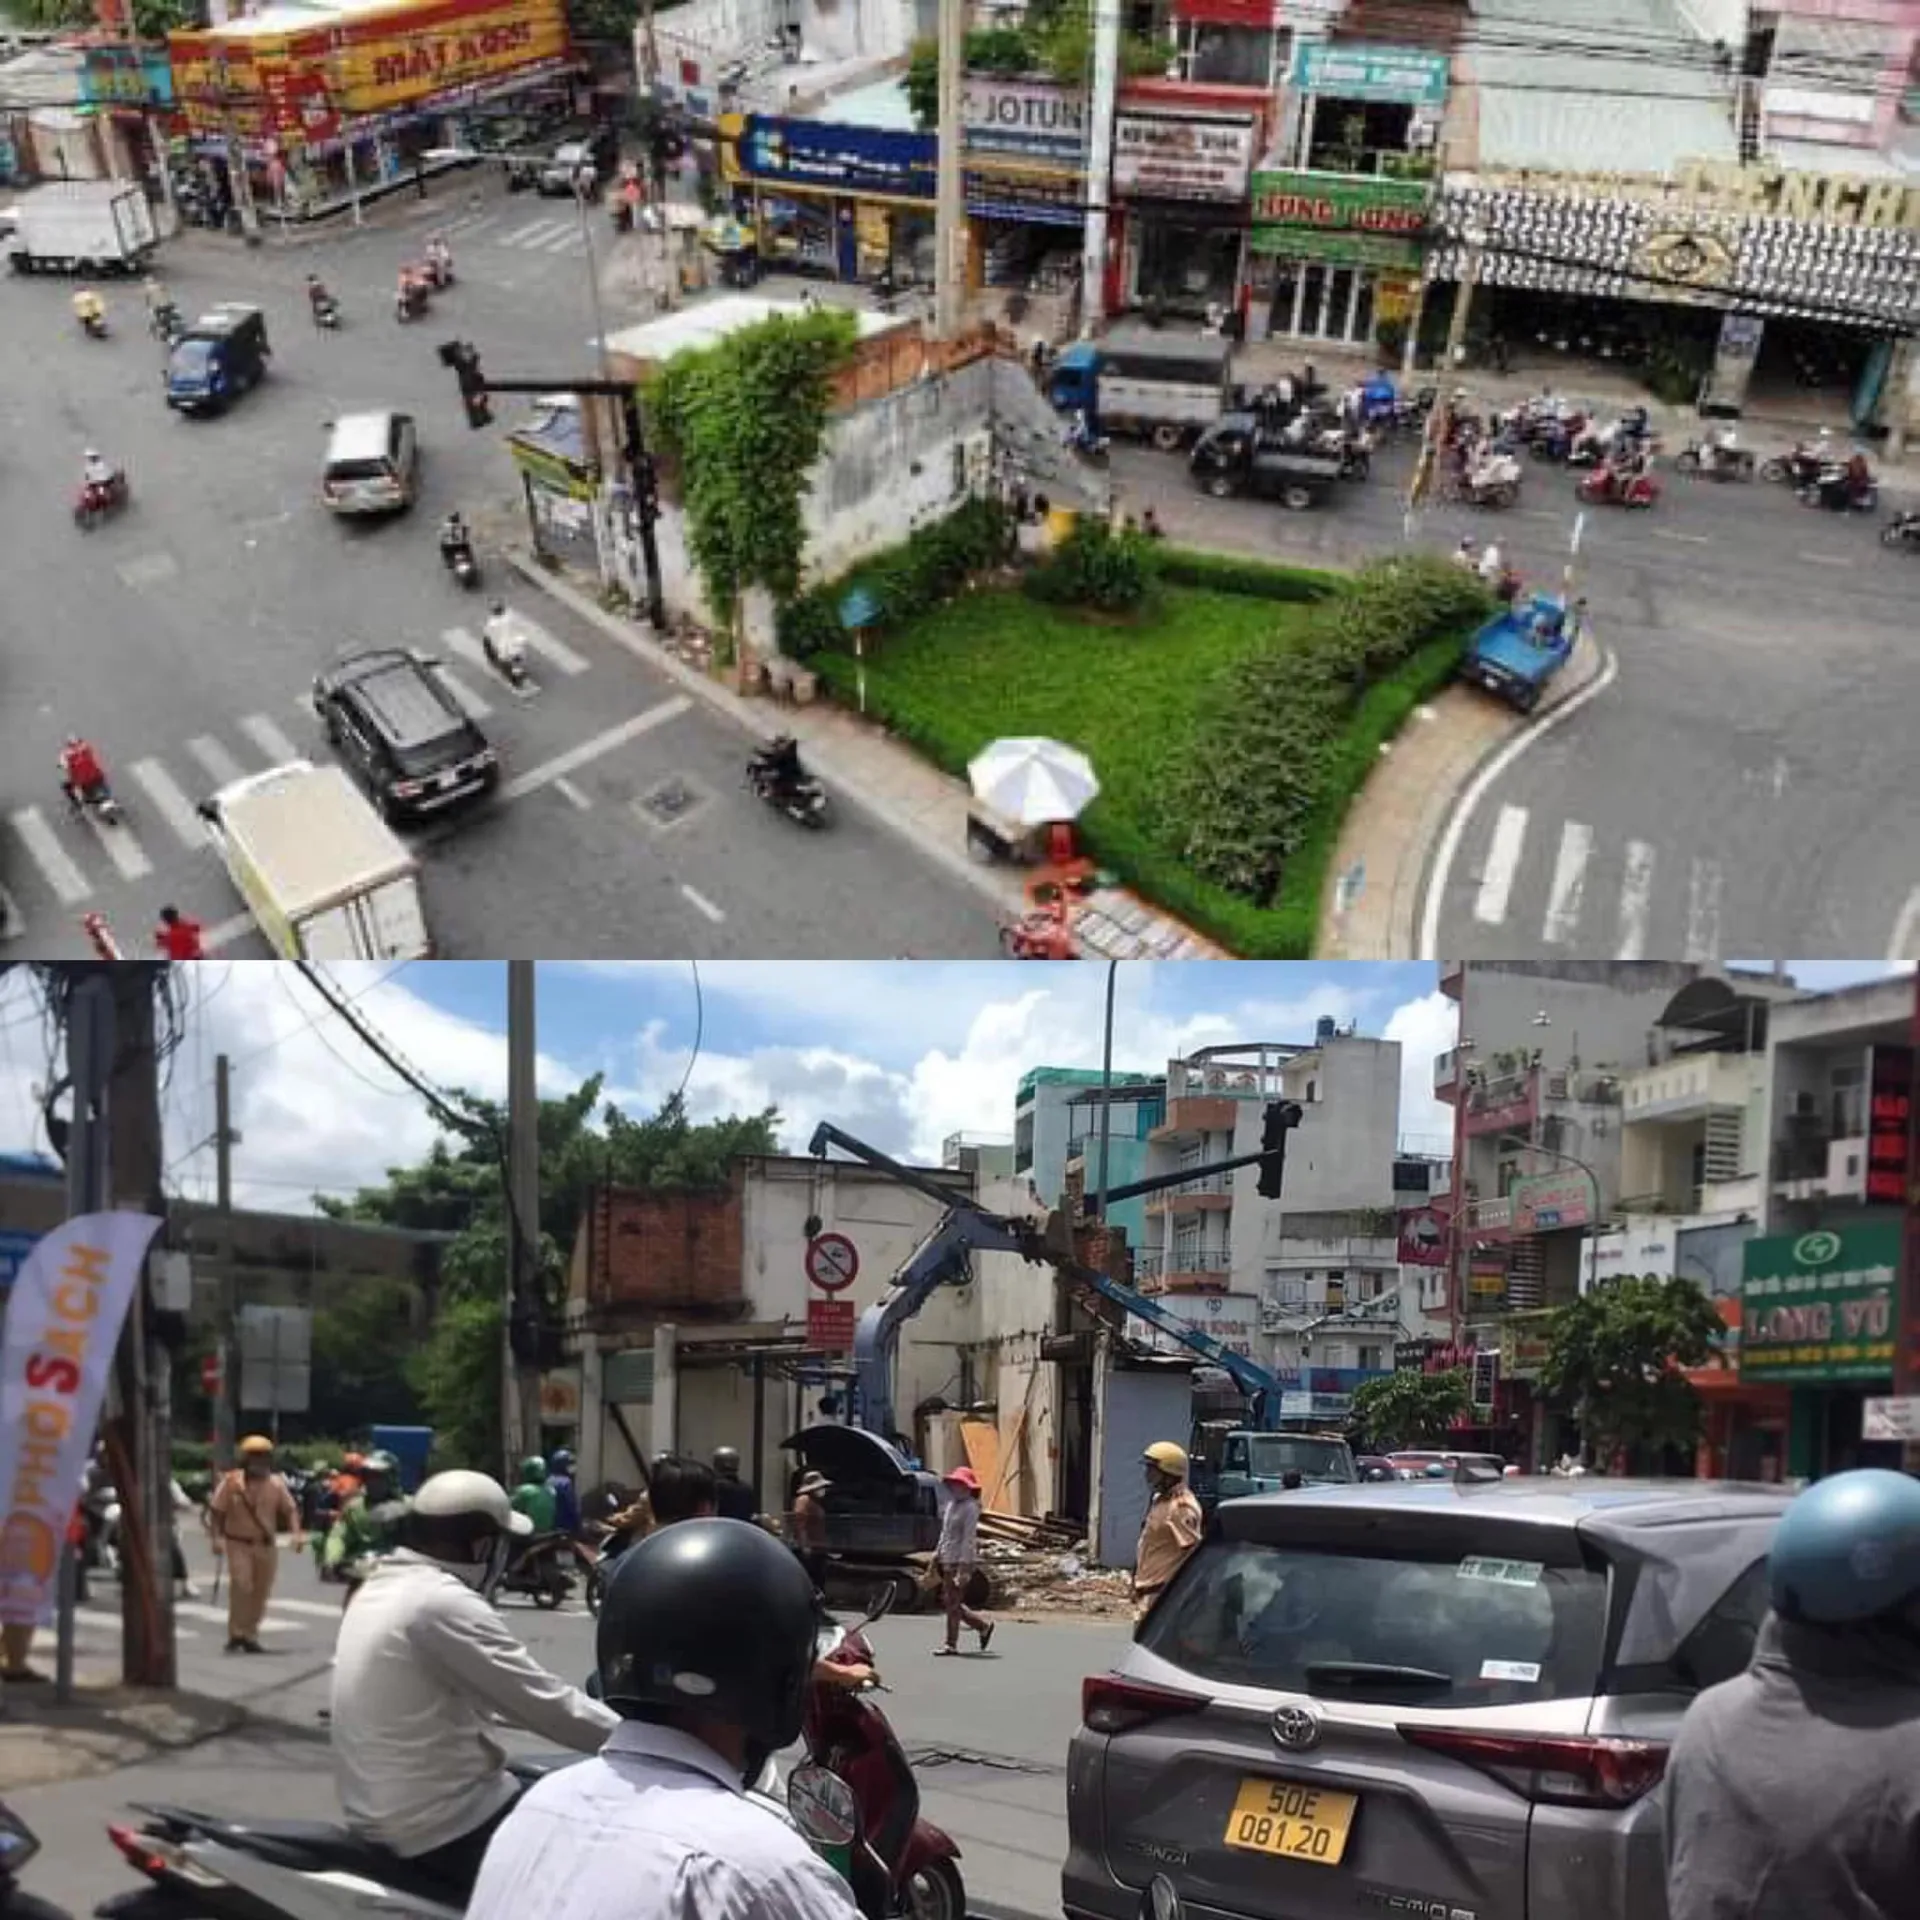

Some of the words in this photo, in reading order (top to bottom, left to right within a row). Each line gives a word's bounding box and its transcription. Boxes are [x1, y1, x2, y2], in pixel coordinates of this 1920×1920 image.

[984, 95, 1083, 129] JOTUN
[1745, 1303, 1833, 1343] LONG
[1268, 1782, 1320, 1820] 50E
[1239, 1814, 1331, 1857] 081.20
